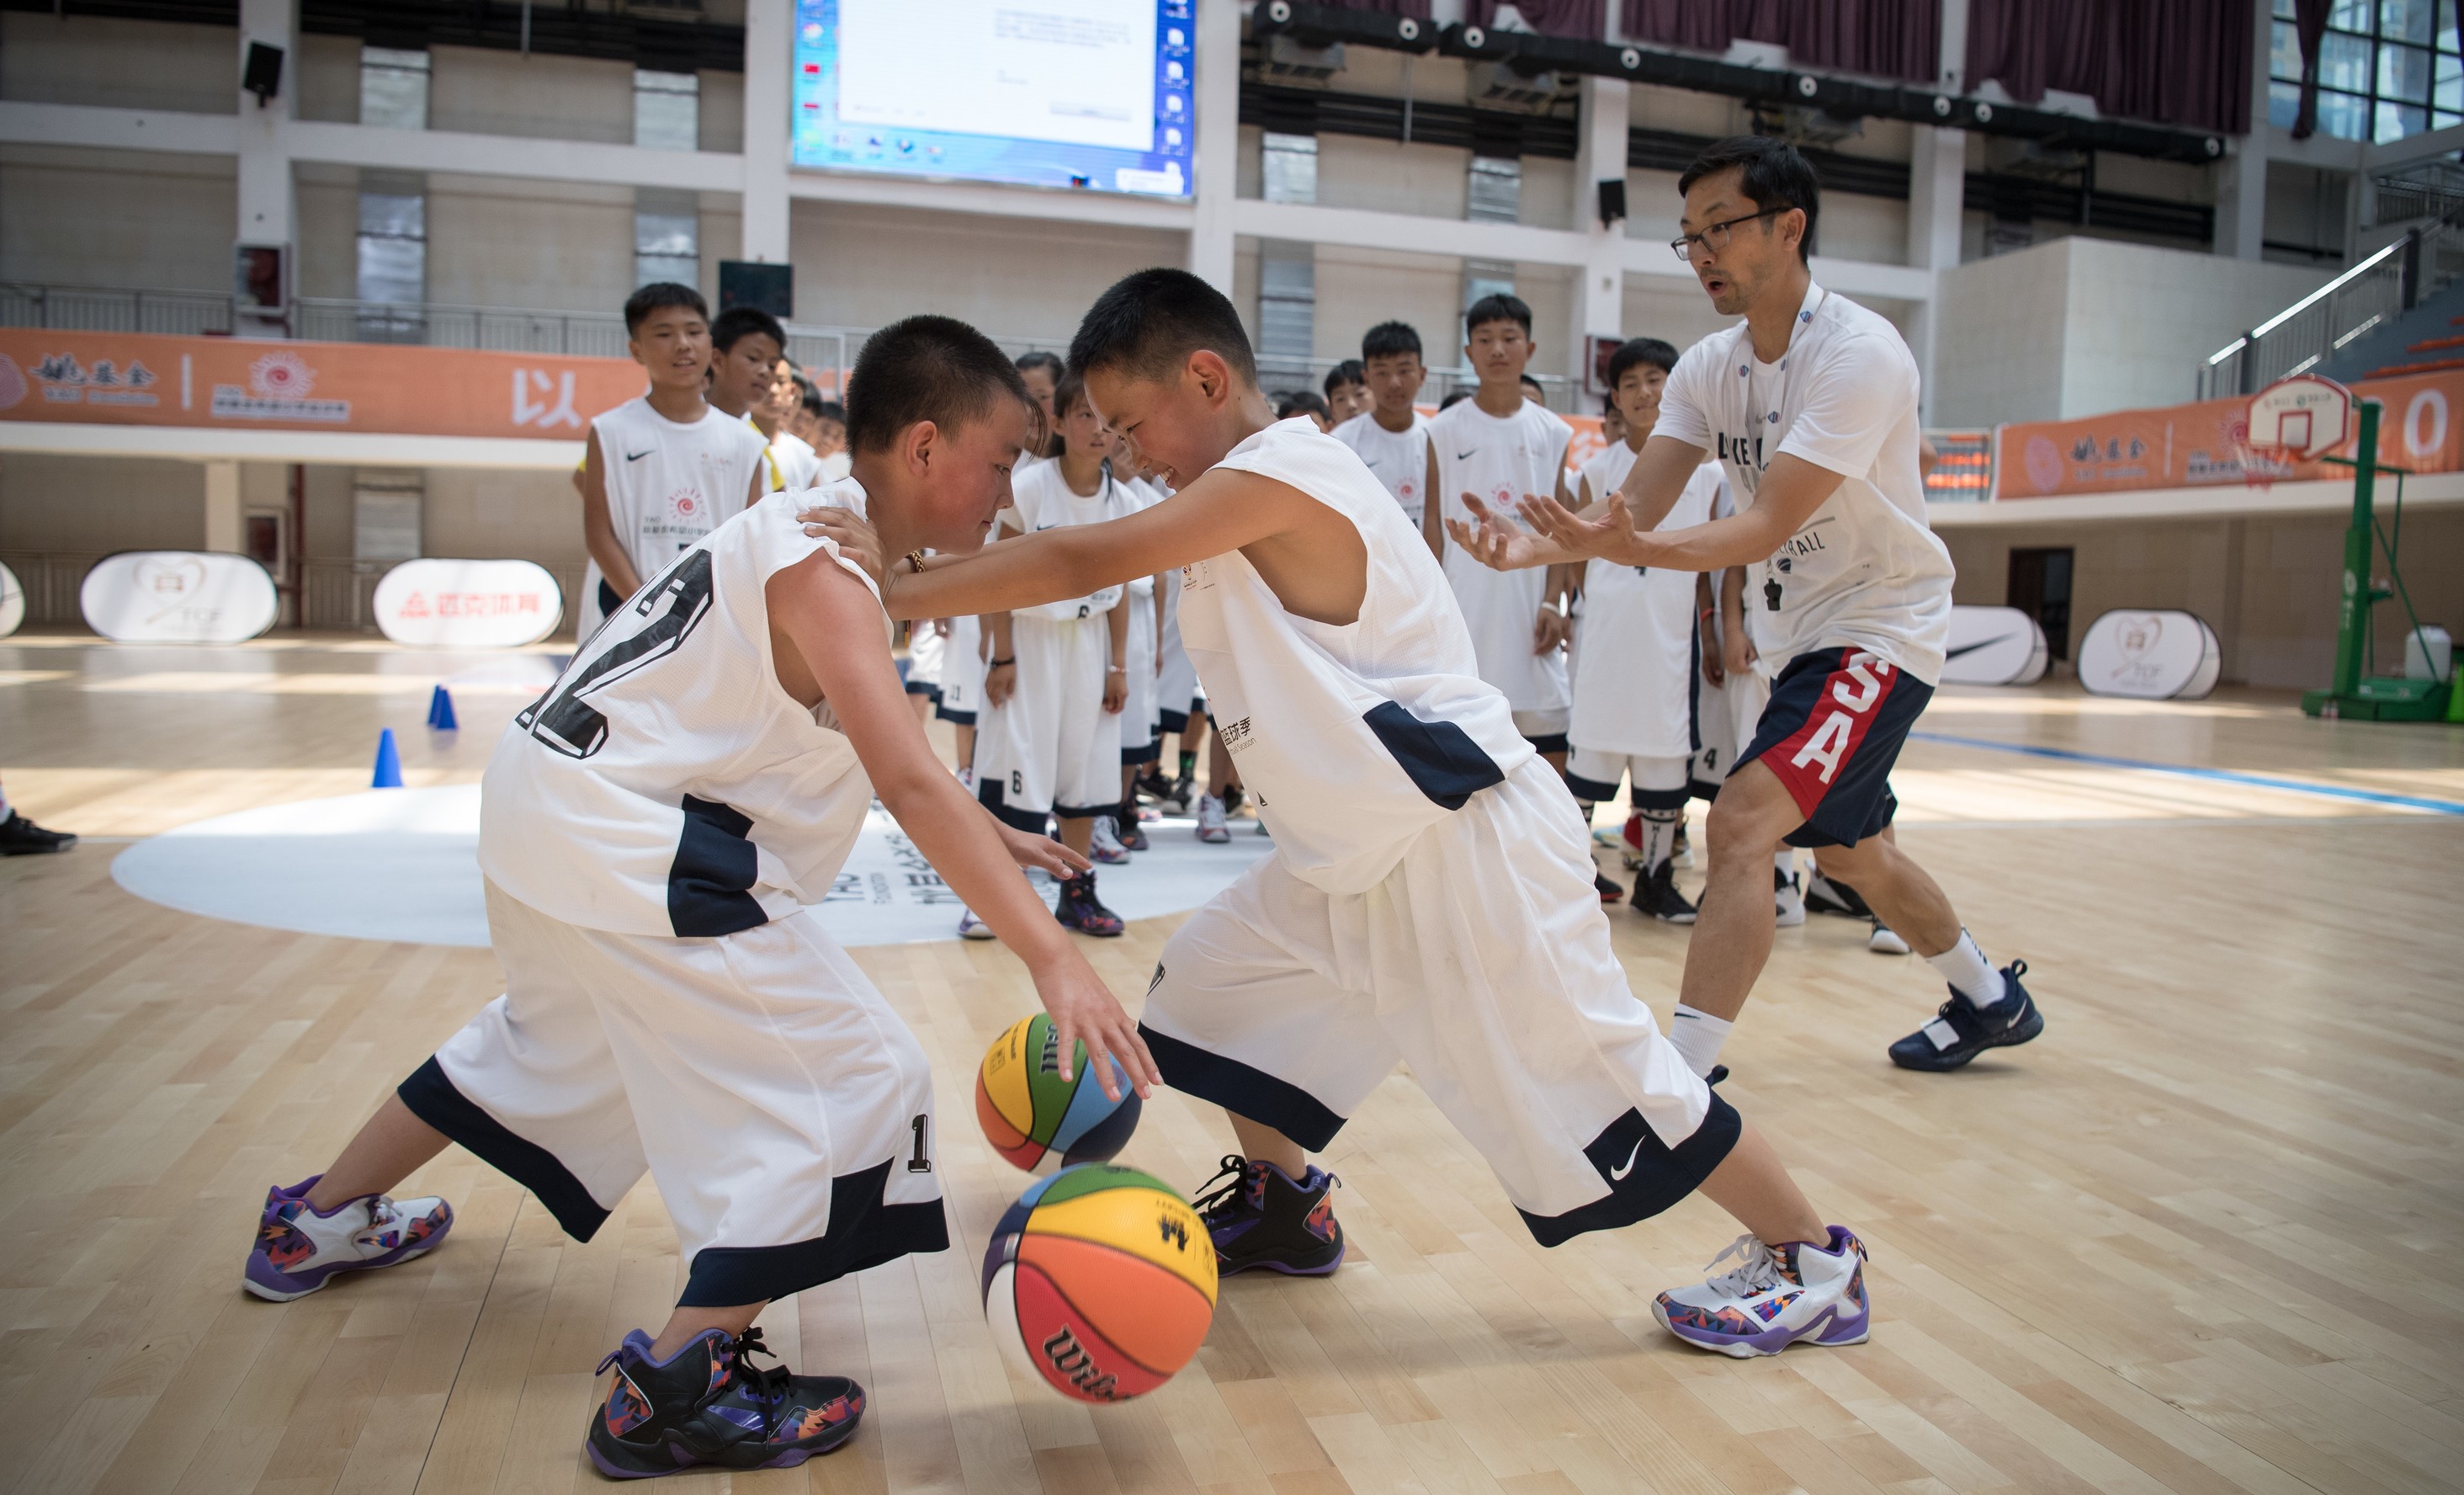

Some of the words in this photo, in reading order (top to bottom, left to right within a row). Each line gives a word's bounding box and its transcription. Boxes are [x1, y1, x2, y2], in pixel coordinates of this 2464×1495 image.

[512, 369, 582, 429] 以
[1237, 737, 1257, 752] Season
[1704, 748, 1718, 770] 4
[1012, 769, 1022, 795] 6
[907, 1113, 932, 1173] 1
